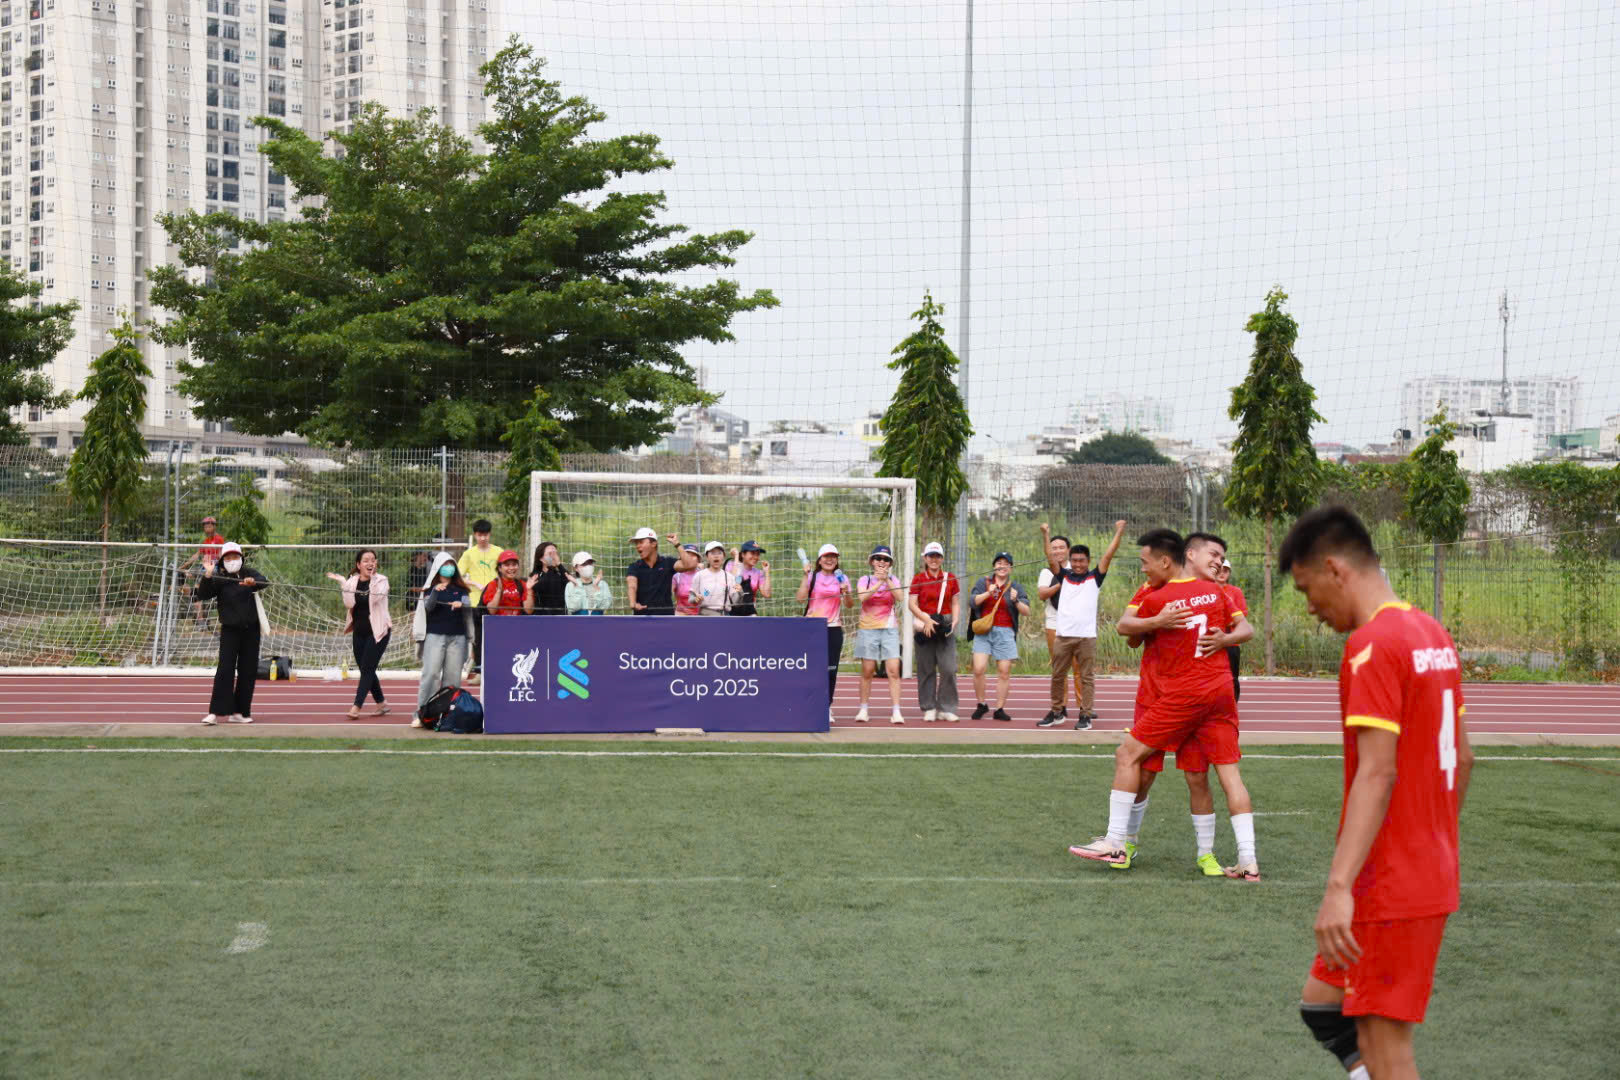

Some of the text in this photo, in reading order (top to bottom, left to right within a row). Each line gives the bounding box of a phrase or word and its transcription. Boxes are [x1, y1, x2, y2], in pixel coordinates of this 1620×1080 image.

[1189, 593, 1217, 607] GROUP
[1185, 613, 1208, 658] 7
[619, 652, 807, 670] Standard Chartered
[669, 679, 759, 701] Cup 2025
